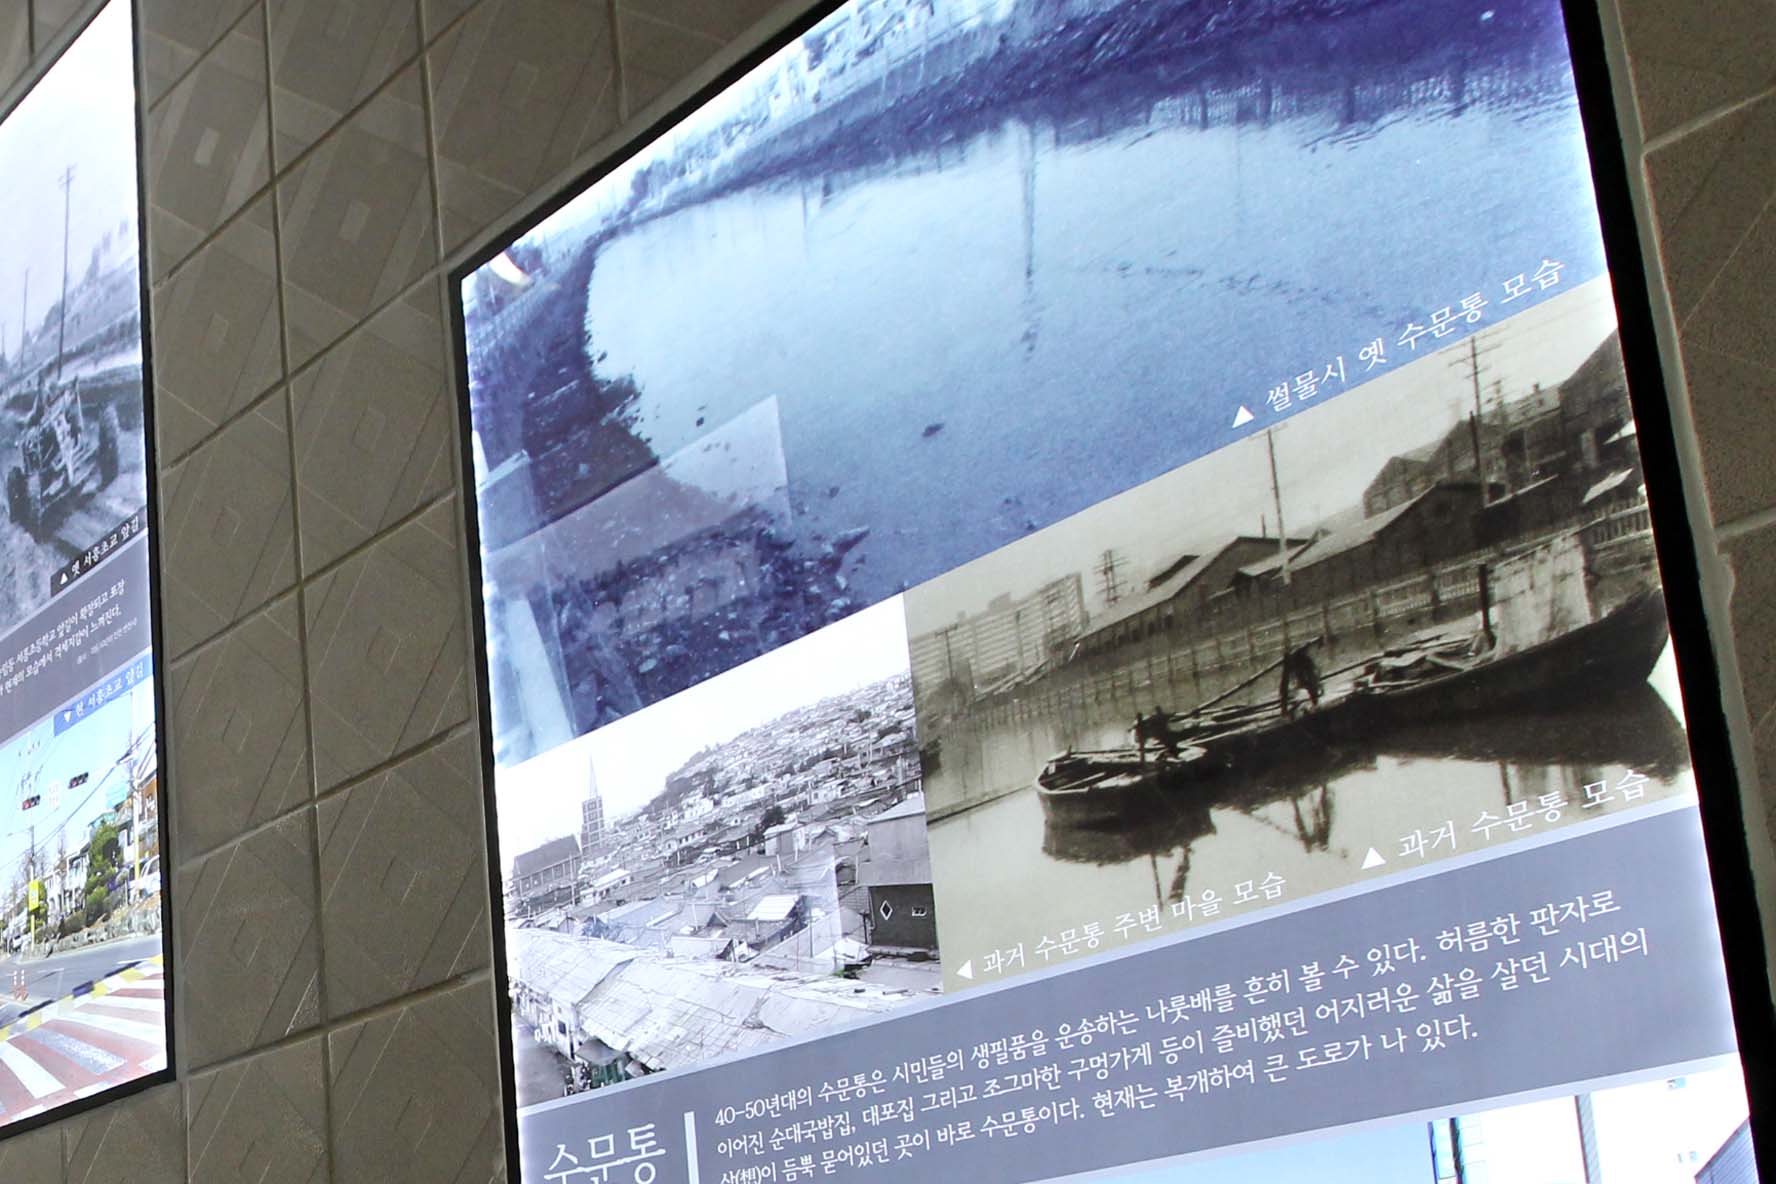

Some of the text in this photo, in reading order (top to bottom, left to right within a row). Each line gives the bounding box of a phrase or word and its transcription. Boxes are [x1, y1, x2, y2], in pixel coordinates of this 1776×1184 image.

[1265, 258, 1565, 413] 썰물시 옛 수문통 모습
[1399, 769, 1650, 862] 과거 수문통 모습
[983, 870, 1287, 976] 과거 수문통 주변 마을 모습
[714, 888, 1621, 1126] 40-50년대의 수문통은 시민들의 생필품을 운송하는 나룻배를 흔히 볼 수 있다. 허름한 판자로
[718, 927, 1650, 1160] 이어진 순대국밥집, 대포집 그리고 조그마한 구멍가게 등이 즐비했던 어지러운 삶을 살던 시대의
[782, 1152, 817, 1184] 듬뿍
[820, 1138, 891, 1174] 묻어있던
[896, 1128, 932, 1160] 곳이
[937, 1118, 976, 1151] 바로
[980, 1096, 1086, 1140] 수문통이다.
[1092, 1083, 1159, 1121] 현재는
[1163, 1059, 1256, 1108] 복개하여
[1263, 1053, 1288, 1084] 큰
[1295, 1031, 1373, 1076] 도로가
[1381, 1022, 1408, 1058] 나
[1414, 1012, 1480, 1054] 있다.
